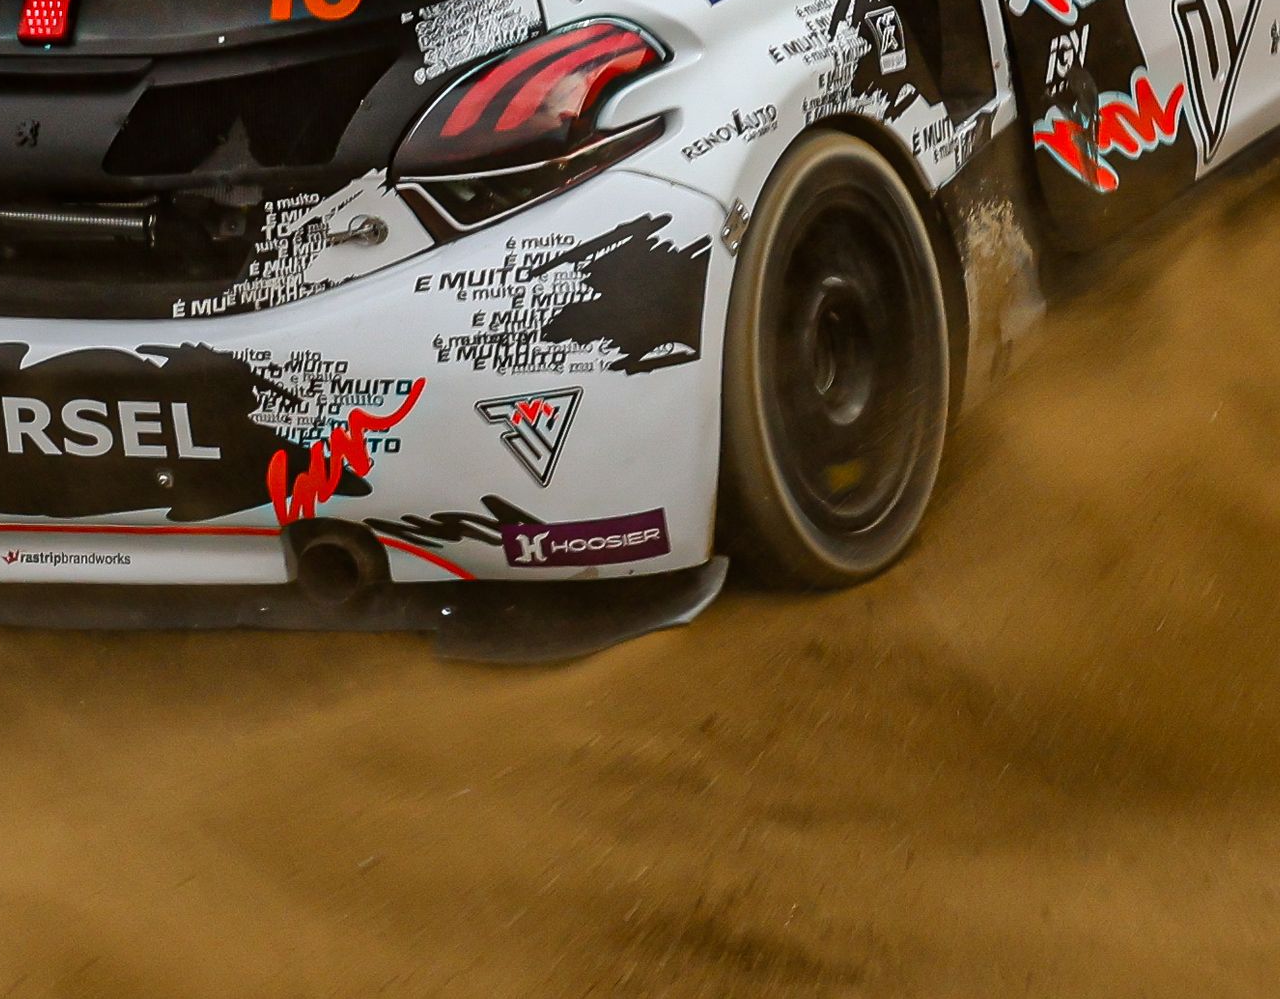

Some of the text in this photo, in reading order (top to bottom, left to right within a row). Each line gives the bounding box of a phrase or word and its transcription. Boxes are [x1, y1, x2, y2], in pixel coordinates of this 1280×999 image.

[521, 233, 576, 248] muito
[439, 267, 534, 291] MUITO
[473, 283, 526, 301] muito
[330, 379, 412, 396] MUITO
[551, 528, 660, 554] HOOSIER
[20, 549, 131, 567] rastripbrandworks
